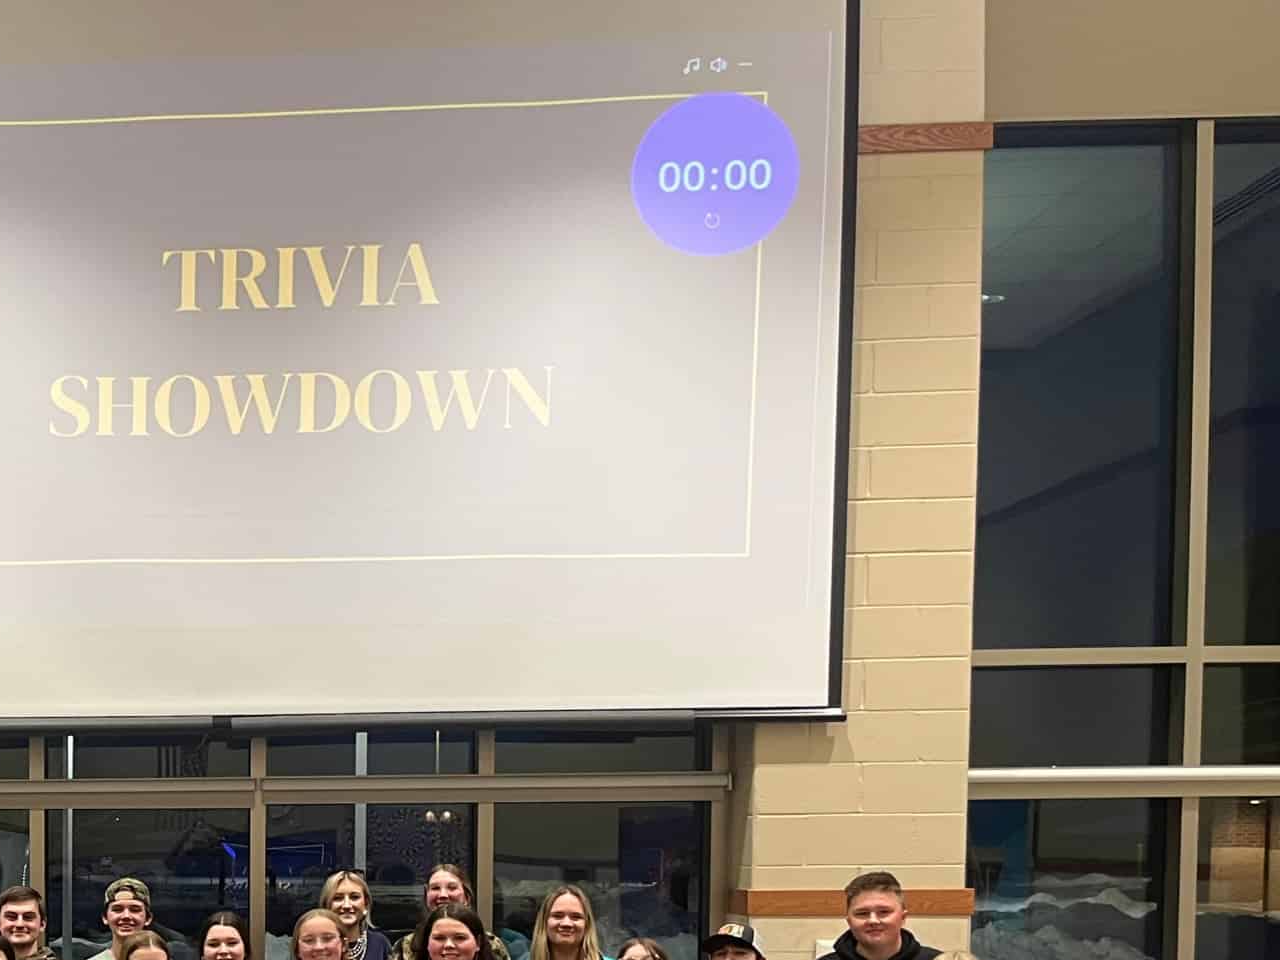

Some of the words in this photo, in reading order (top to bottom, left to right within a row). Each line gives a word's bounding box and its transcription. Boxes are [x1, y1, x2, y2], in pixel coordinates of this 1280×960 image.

[658, 158, 772, 193] 00:00
[162, 242, 441, 312] TRIVIA
[48, 365, 556, 438] SHOWDOWN
